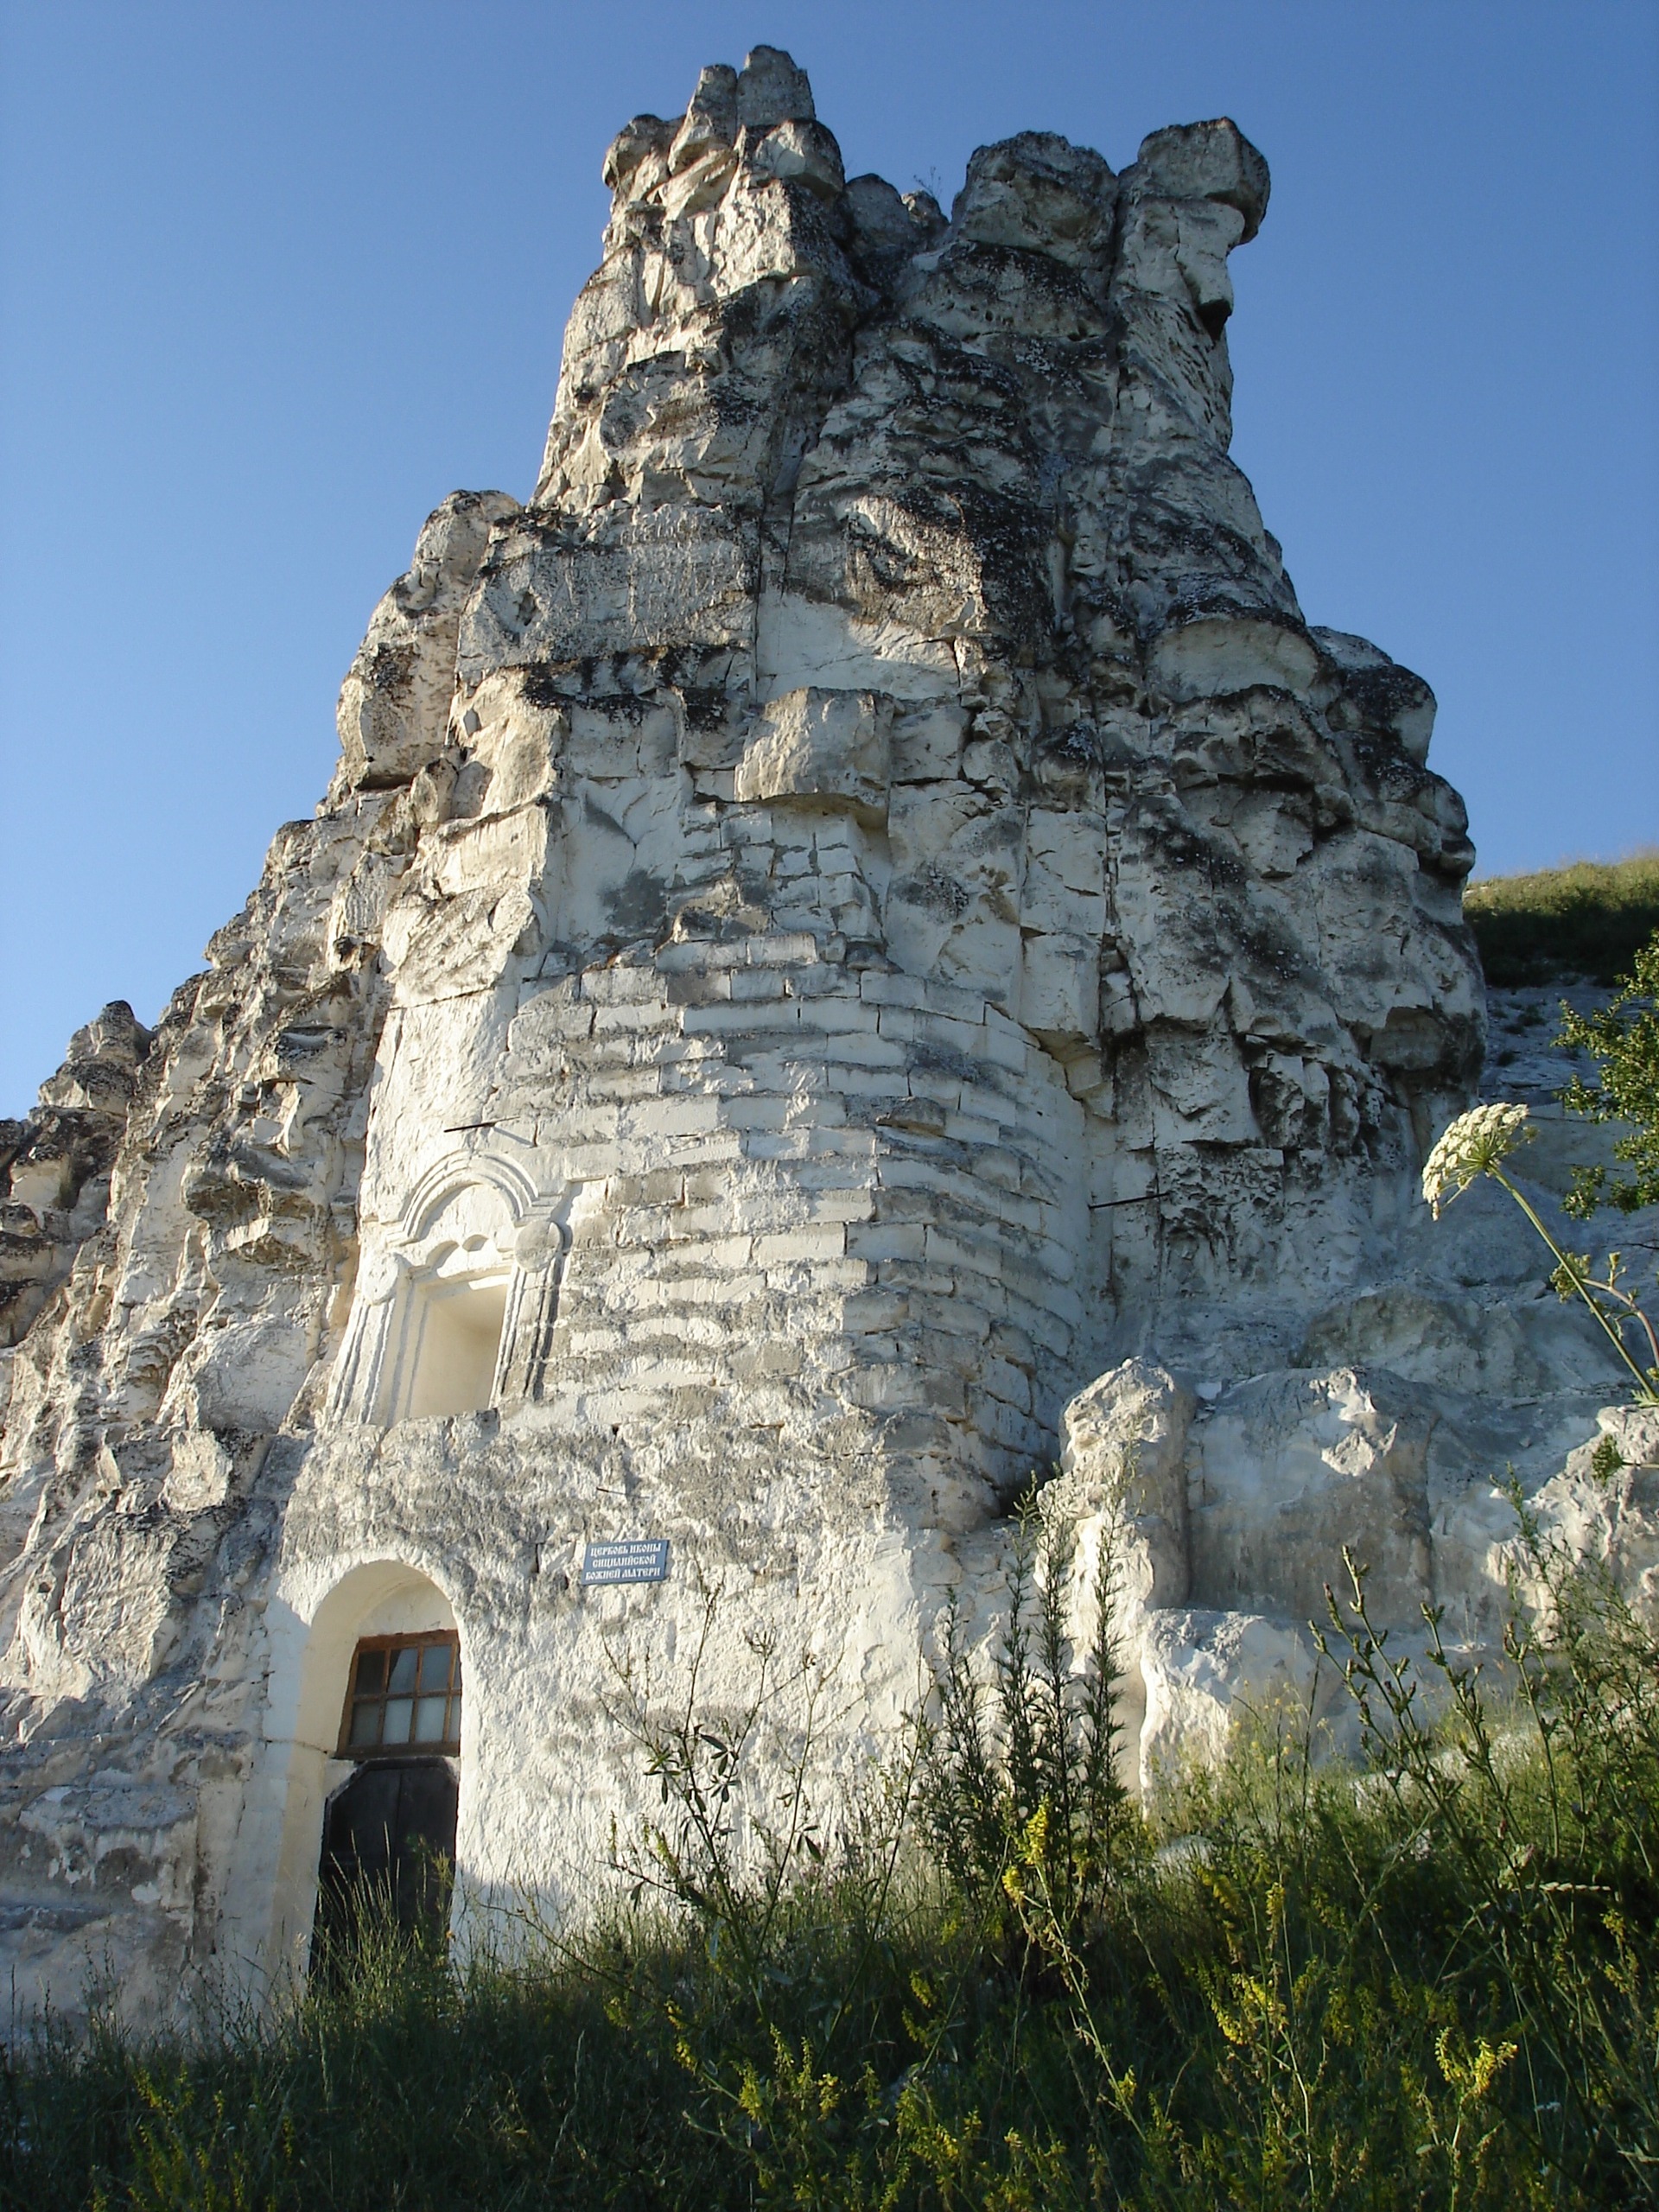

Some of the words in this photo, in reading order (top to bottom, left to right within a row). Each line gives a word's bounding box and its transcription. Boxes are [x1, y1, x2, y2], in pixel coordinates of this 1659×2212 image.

[590, 1545, 628, 1557] ЦЕРКОВЬ
[630, 1543, 661, 1554] ИКОНЫ
[592, 1554, 656, 1568] СИЦИЛИЙСКОЙ
[585, 1568, 620, 1580] БОЖИЕЙ
[621, 1567, 660, 1578] МАТЕРИ
